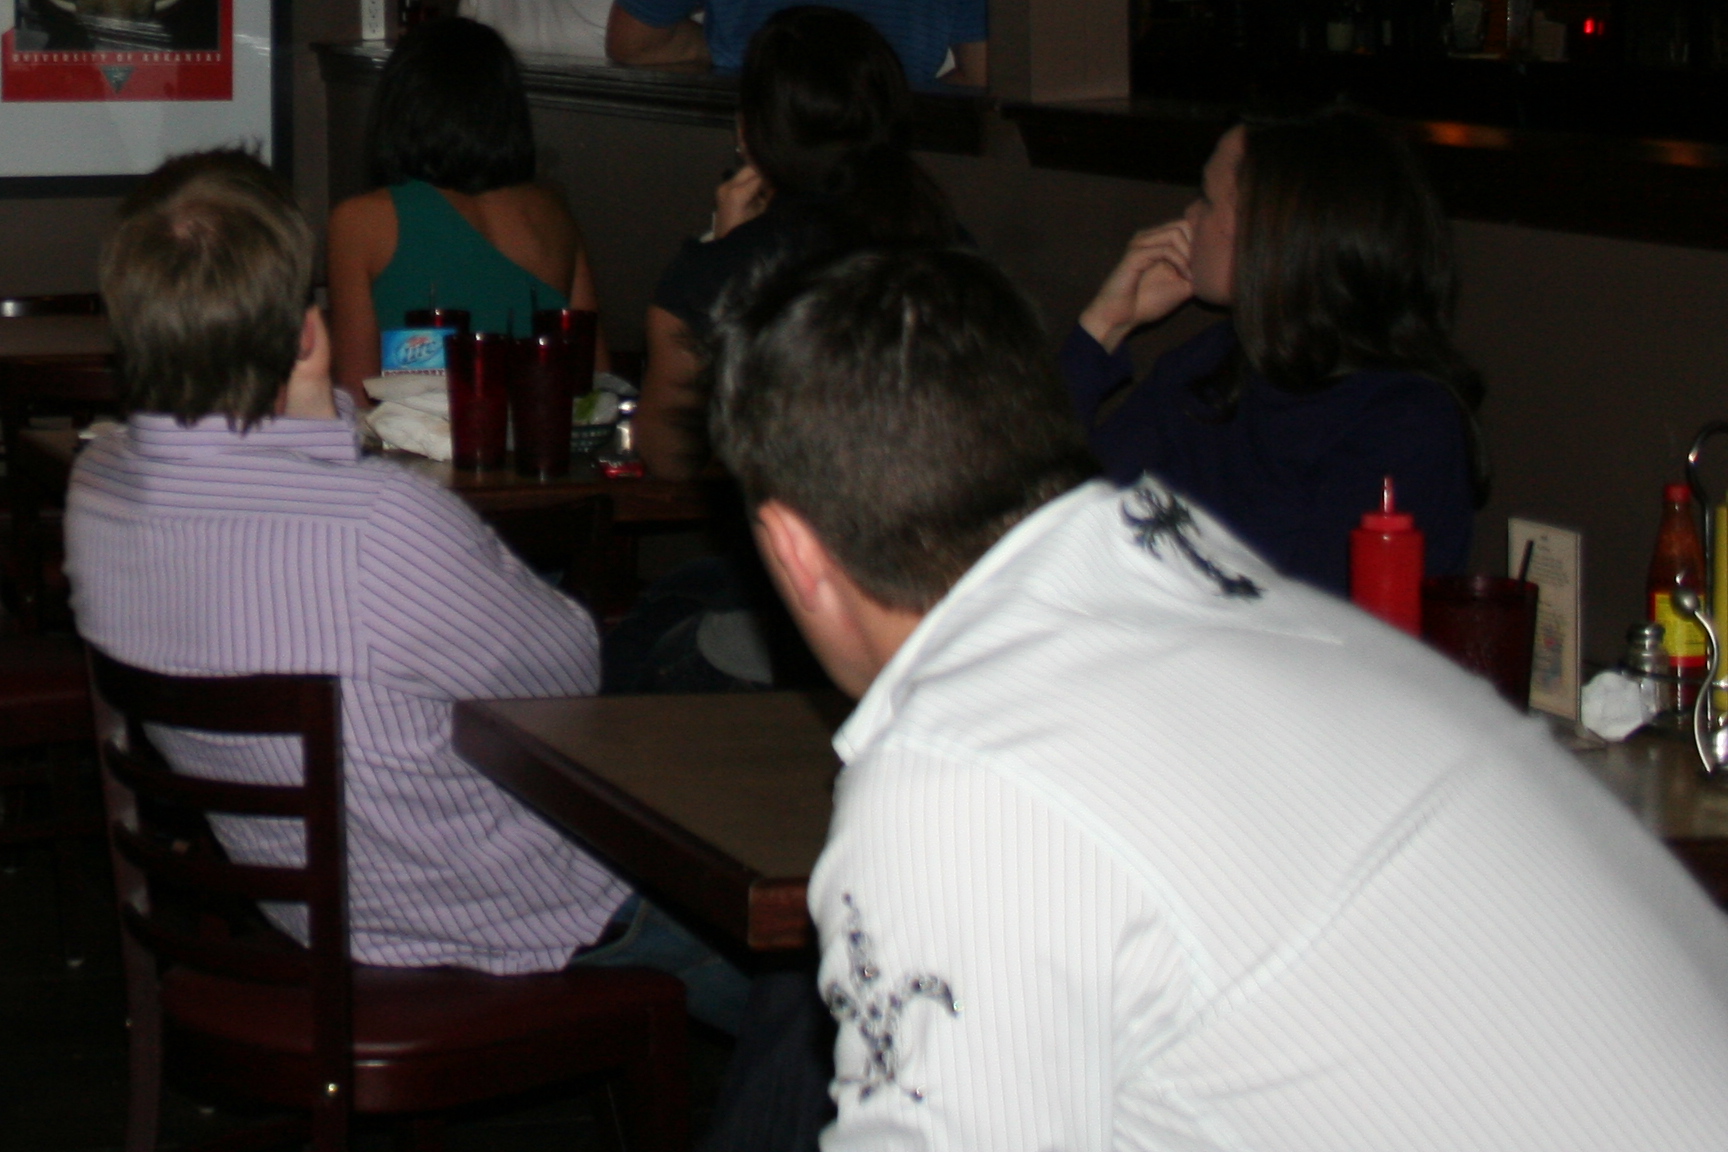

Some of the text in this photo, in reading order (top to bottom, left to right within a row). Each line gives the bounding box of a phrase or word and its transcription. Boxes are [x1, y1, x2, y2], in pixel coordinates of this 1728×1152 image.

[12, 52, 221, 63] UNIVERSITY OF ARKANSAS
